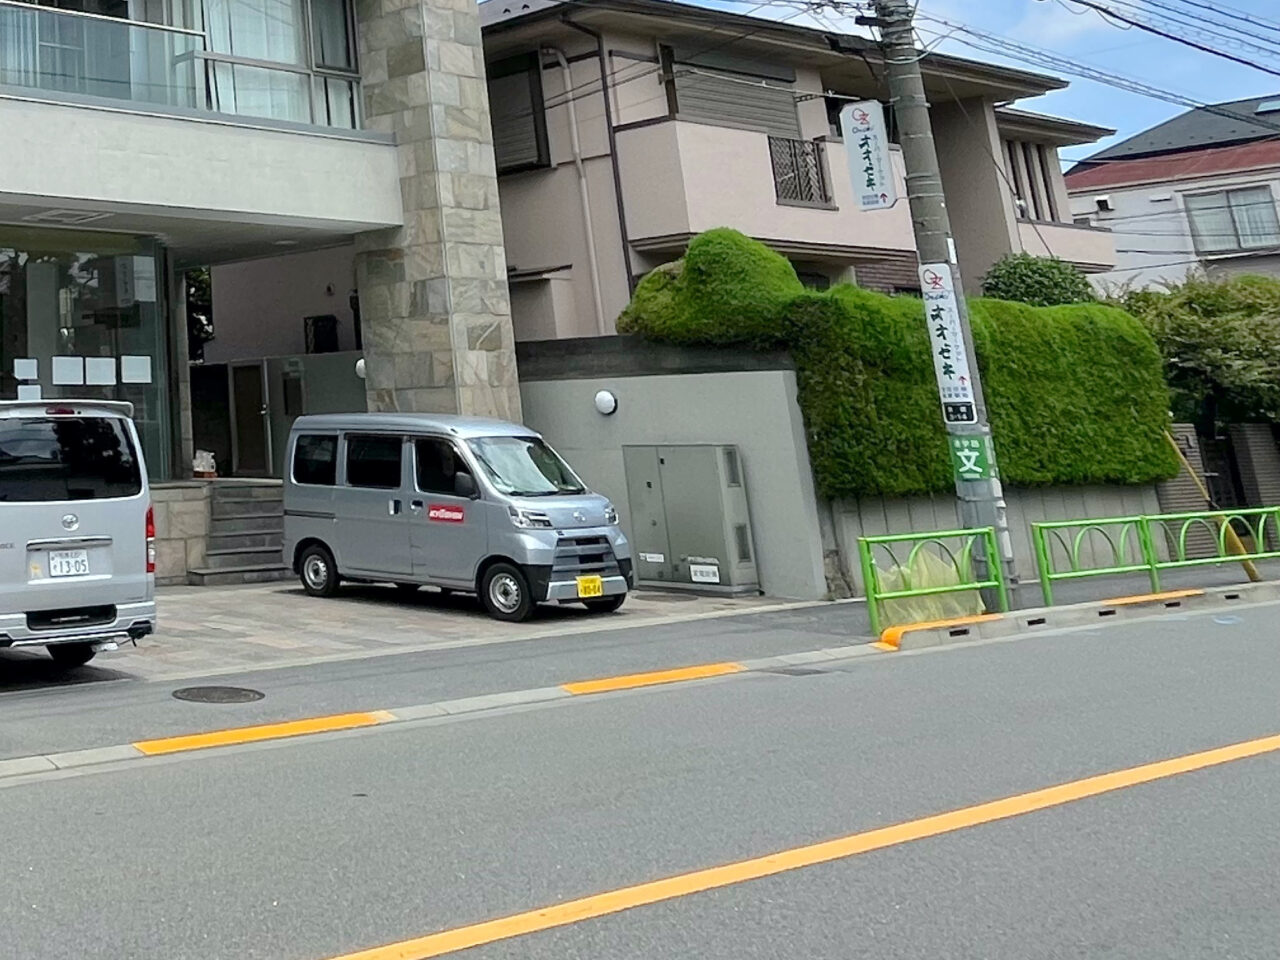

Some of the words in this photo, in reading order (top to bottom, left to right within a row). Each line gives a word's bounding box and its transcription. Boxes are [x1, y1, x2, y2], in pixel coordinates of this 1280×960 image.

[930, 303, 956, 381] オオゼキ
[956, 448, 983, 473] 文
